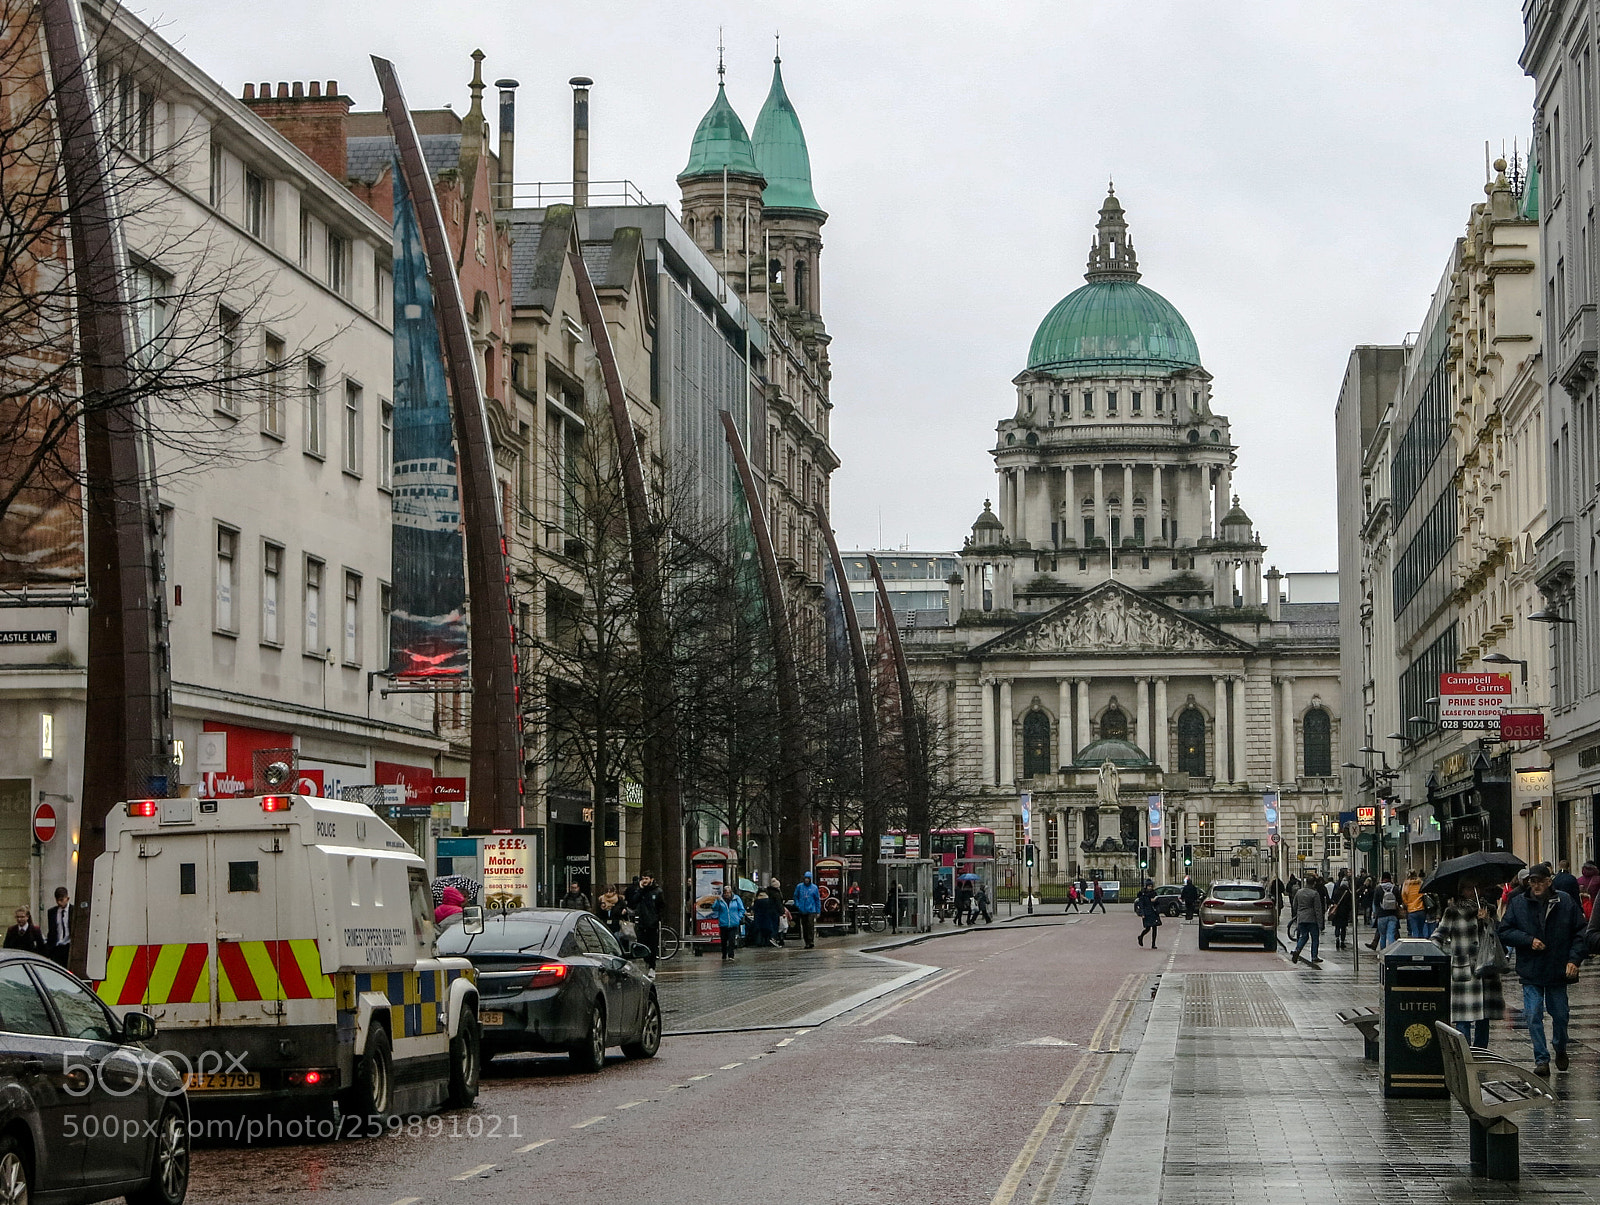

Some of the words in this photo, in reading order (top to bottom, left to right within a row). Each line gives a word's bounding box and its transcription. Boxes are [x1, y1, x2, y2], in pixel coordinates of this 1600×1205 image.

[0, 633, 28, 642] CASTLE
[31, 632, 52, 642] LANE
[1447, 676, 1491, 685] Campbell
[1475, 684, 1504, 692] Cairns
[1441, 720, 1459, 729] 028
[1462, 720, 1485, 729] 9024
[1487, 720, 1501, 729] 90
[1519, 784, 1550, 792] LOOK
[1358, 808, 1374, 817] DW
[316, 821, 336, 838] POLICE
[488, 856, 516, 865] Motor
[484, 866, 524, 875] nsurance
[1399, 1002, 1437, 1011] LITTER
[219, 1073, 255, 1087] 3790
